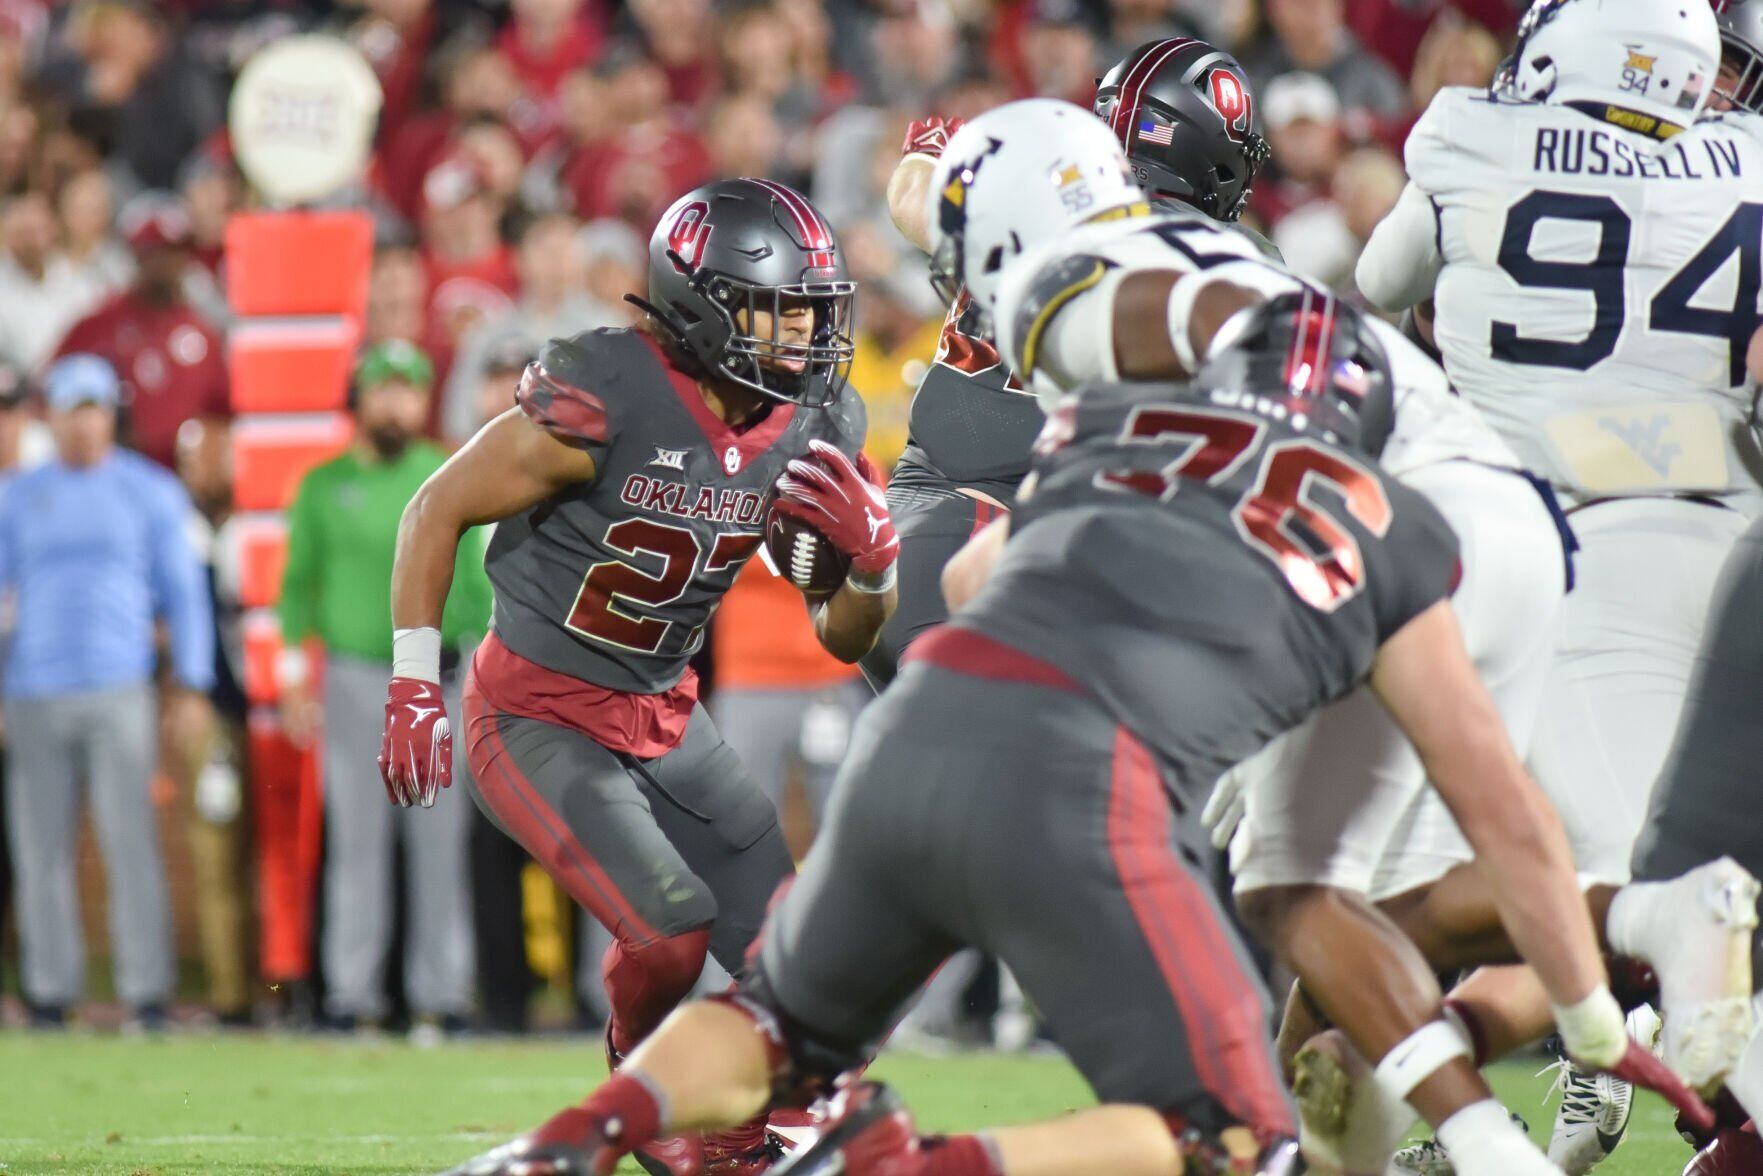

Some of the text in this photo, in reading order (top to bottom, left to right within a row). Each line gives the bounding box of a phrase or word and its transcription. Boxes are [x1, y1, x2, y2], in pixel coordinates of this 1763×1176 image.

[1617, 67, 1651, 97] 94
[1533, 127, 1742, 180] RUSSELL IV
[1490, 188, 1763, 389] 94
[1092, 402, 1394, 615] 76
